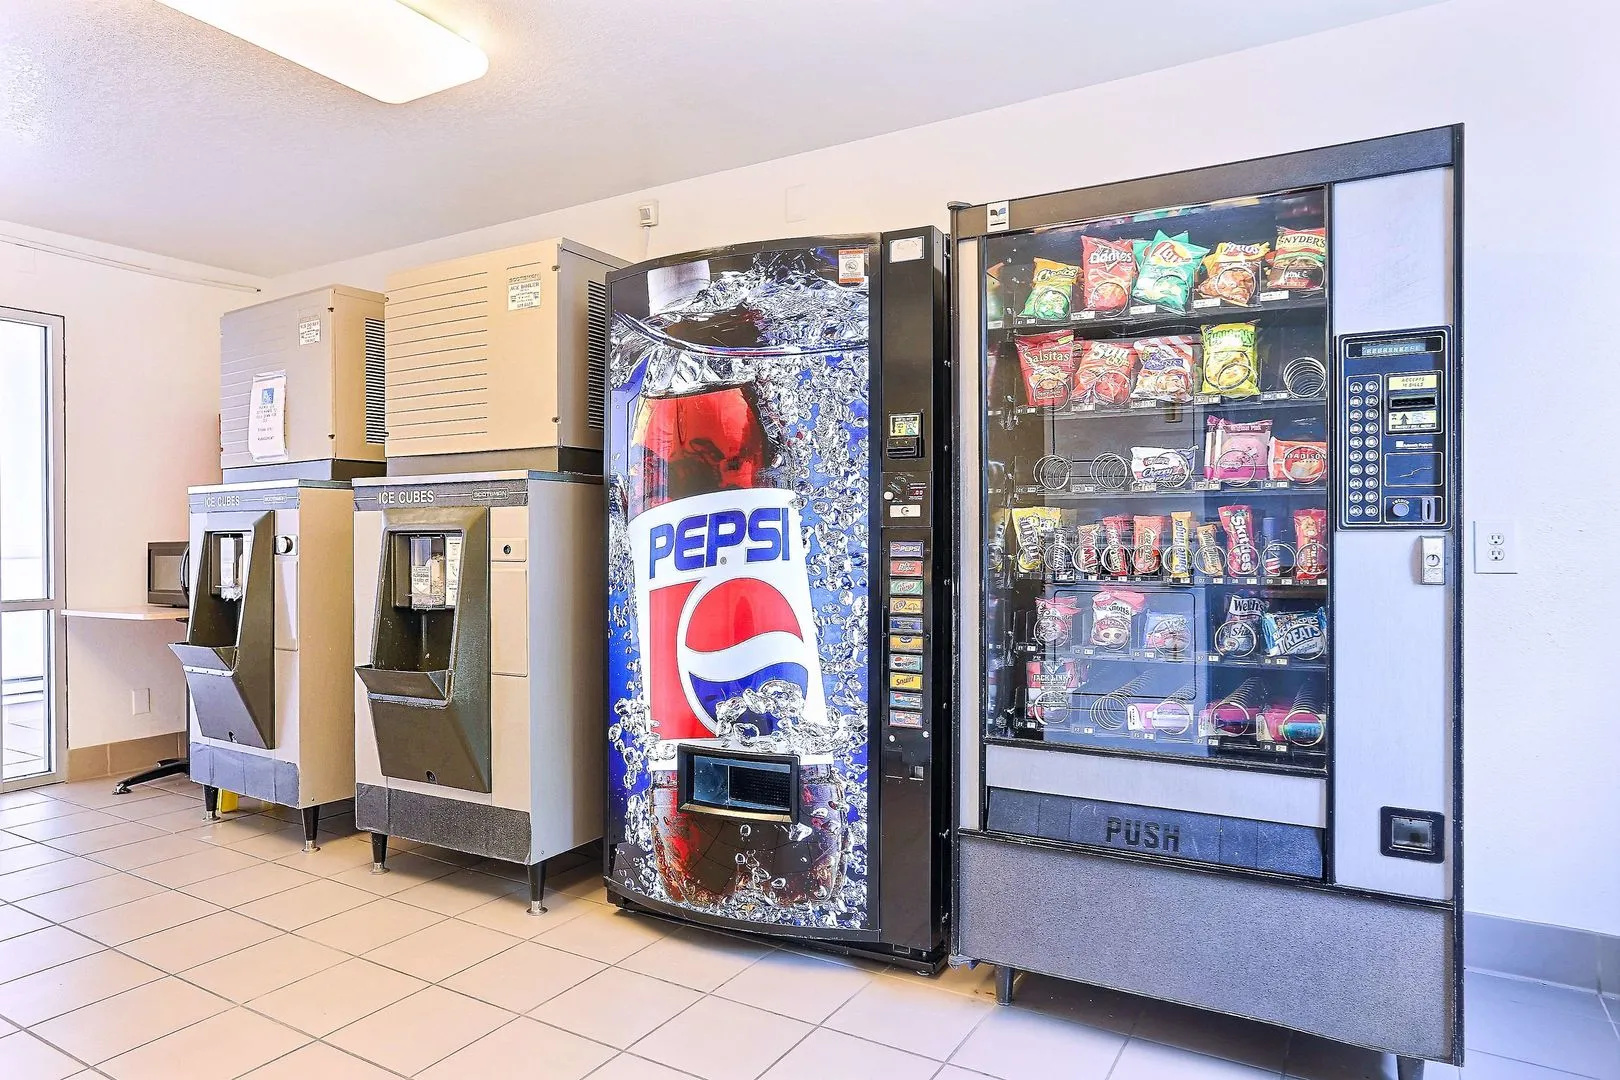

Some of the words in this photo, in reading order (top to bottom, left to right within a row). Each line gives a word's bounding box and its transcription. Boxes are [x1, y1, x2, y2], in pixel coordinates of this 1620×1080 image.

[1024, 351, 1070, 364] Salsitas
[204, 497, 215, 507] ICE
[218, 495, 240, 506] CUBES
[378, 492, 395, 504] ICE
[398, 490, 434, 504] CUBES
[649, 507, 790, 580] PEPSI
[1230, 515, 1251, 572] Skittles
[1275, 626, 1321, 654] TREATS
[1106, 816, 1181, 853] PUSH
